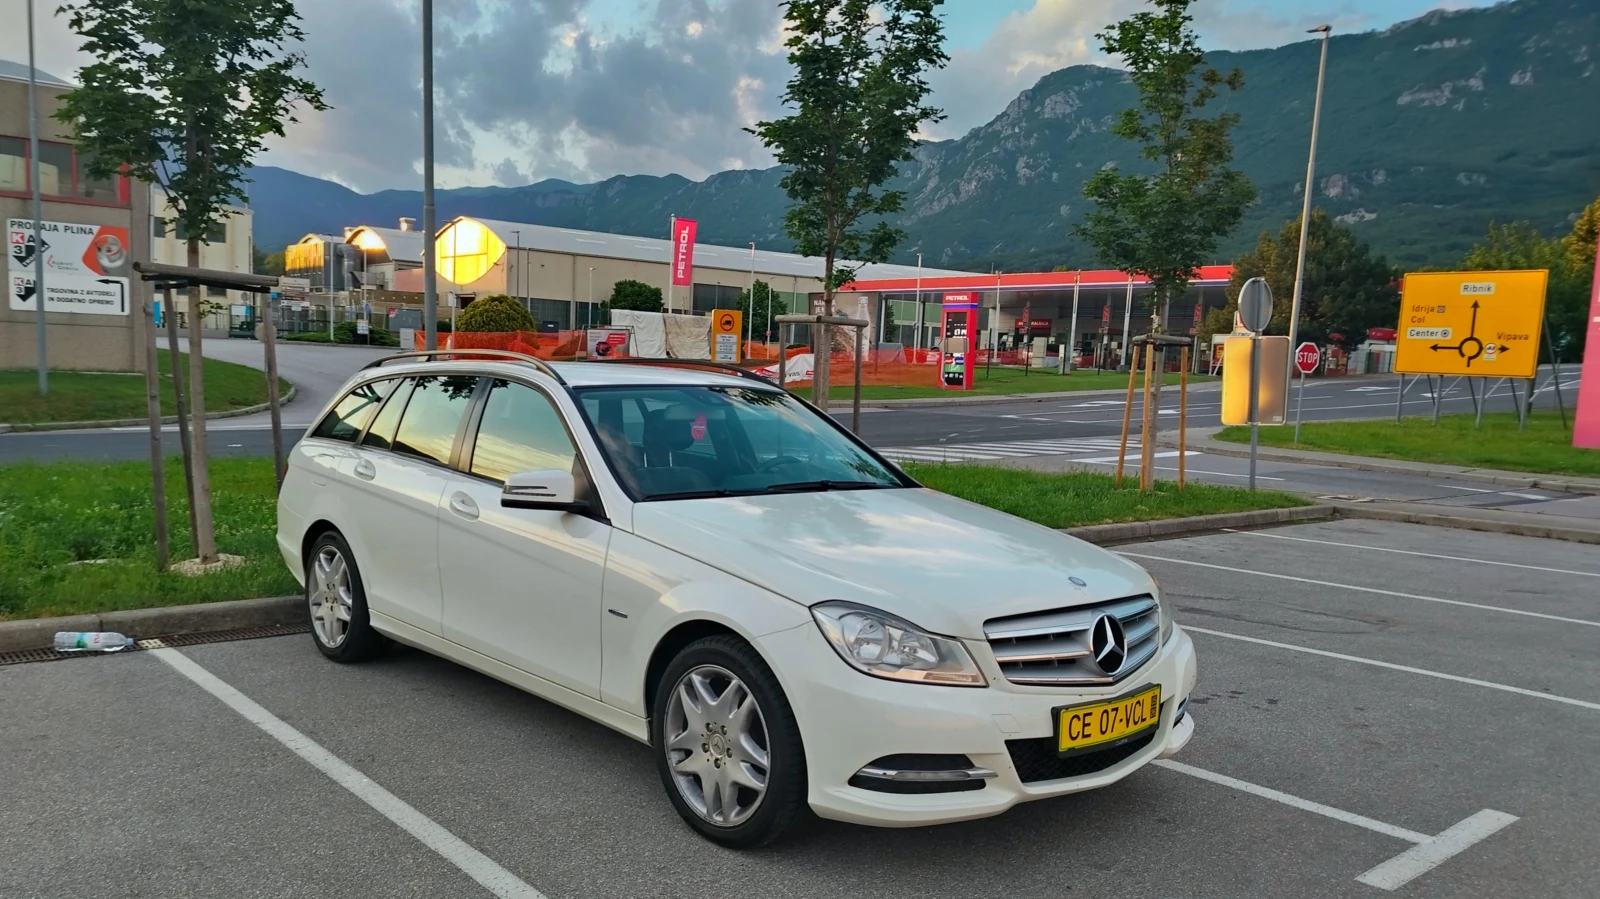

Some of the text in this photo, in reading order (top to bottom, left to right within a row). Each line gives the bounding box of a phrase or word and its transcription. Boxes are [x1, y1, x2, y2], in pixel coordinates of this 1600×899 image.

[64, 225, 94, 235] PLINA
[677, 225, 690, 279] PETROL
[46, 287, 78, 295] TRGOVINA
[1463, 284, 1492, 293] Ribnik
[1412, 304, 1435, 314] Idrija
[1411, 315, 1425, 323] Col
[1409, 329, 1439, 337] Center
[1497, 332, 1529, 341] Vipava
[1298, 352, 1317, 363] STOP
[1068, 712, 1093, 741] CE
[1100, 698, 1147, 736] 07-VCL
